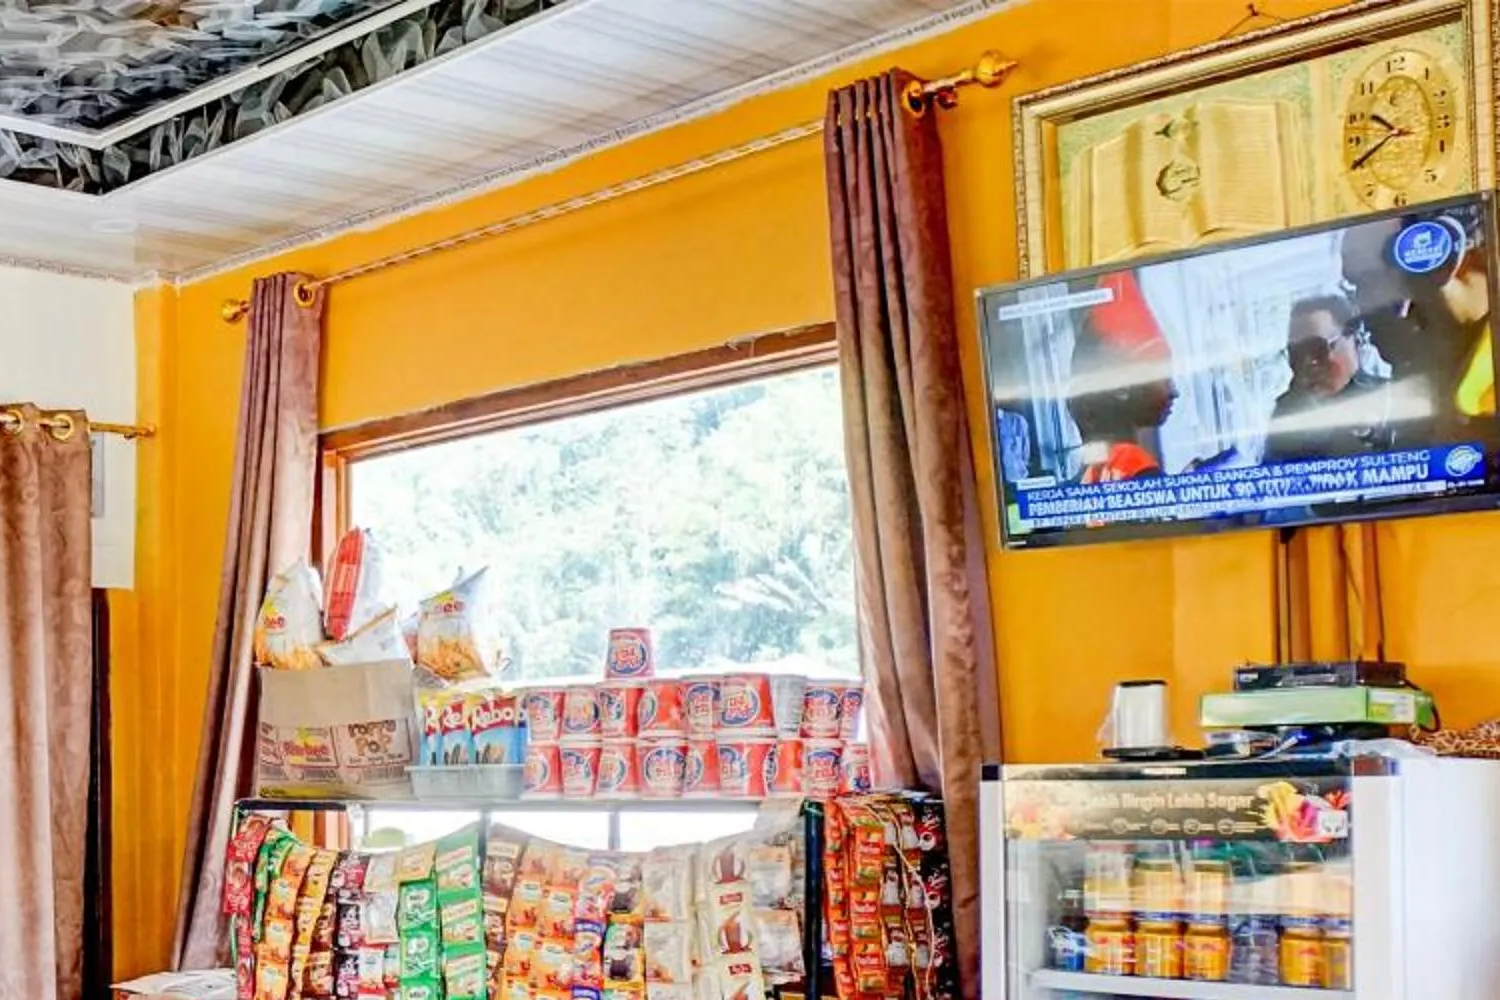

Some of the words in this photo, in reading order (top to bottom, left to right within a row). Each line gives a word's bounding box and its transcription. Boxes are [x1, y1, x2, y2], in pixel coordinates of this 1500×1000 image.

[1065, 485, 1101, 500] SAMA
[1213, 466, 1271, 484] BANGSA
[1360, 449, 1431, 467] SULTENG
[1105, 489, 1177, 509] BEASISWA
[1180, 484, 1232, 502] UNTUK
[1360, 463, 1429, 485] MAMPU
